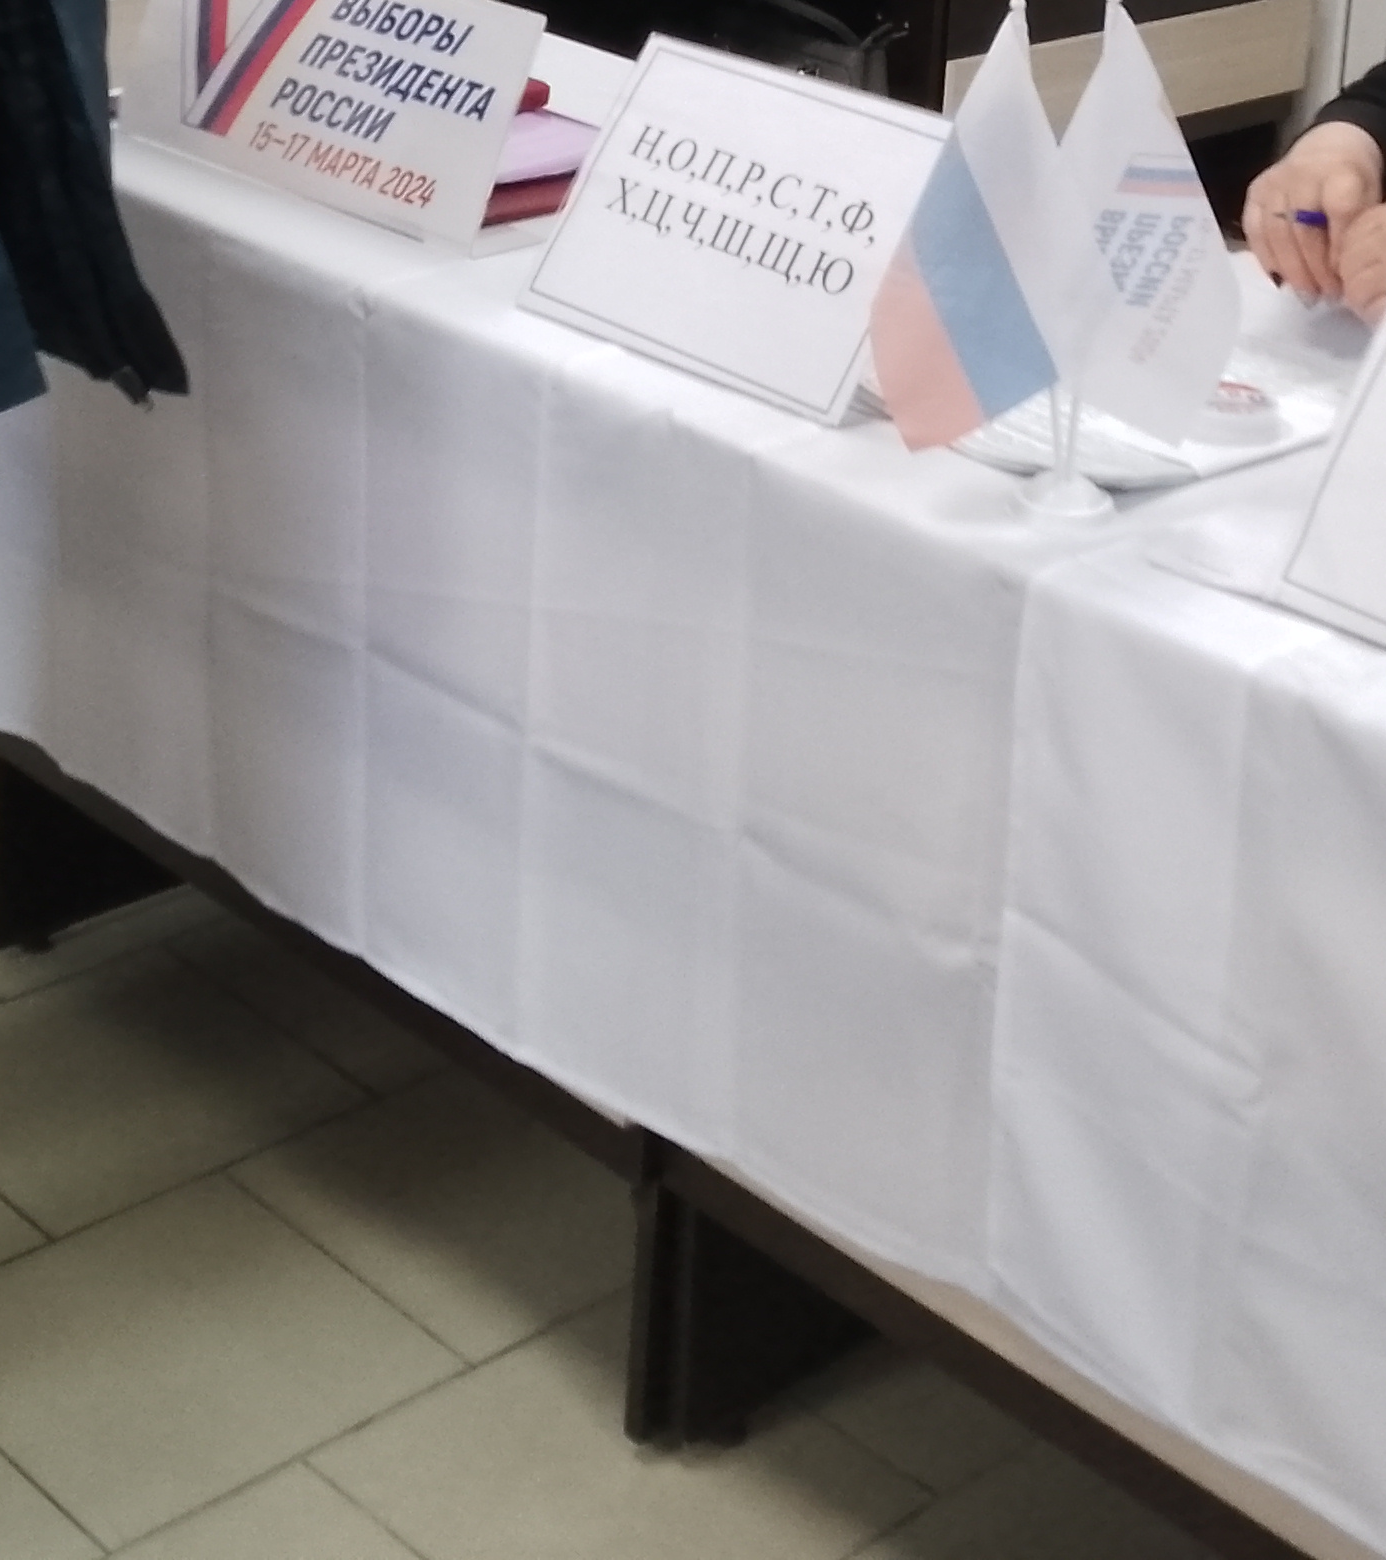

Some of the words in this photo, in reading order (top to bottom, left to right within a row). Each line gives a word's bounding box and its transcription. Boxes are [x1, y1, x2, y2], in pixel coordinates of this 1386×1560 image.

[270, 77, 396, 143] РОССИИ
[299, 33, 497, 122] ПРЕЗИДЕНТА
[304, 140, 382, 189] МАРТА
[379, 166, 437, 209] 2024
